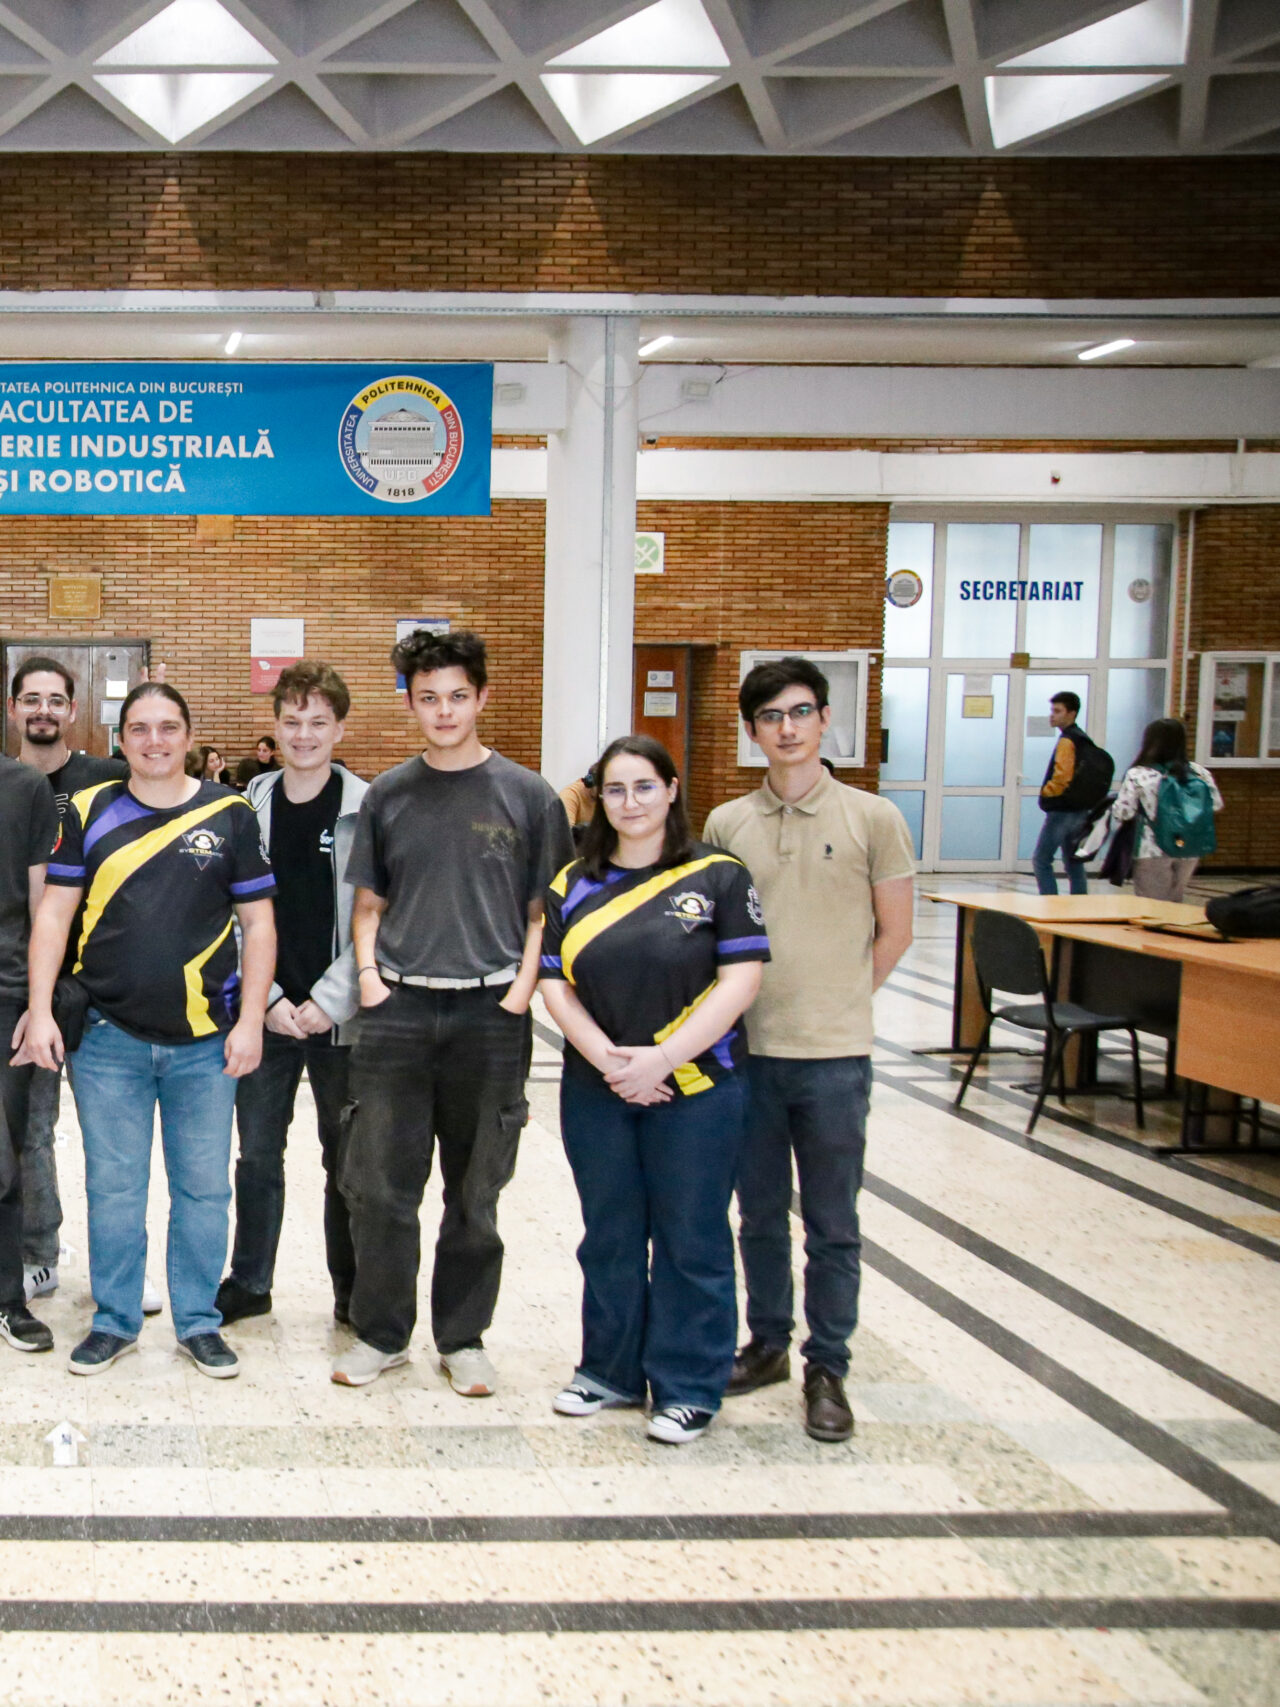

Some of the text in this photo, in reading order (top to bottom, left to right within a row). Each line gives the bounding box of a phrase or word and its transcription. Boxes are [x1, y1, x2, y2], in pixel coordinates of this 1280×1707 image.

[45, 382, 135, 394] POLITEHNICA
[140, 382, 165, 394] DIN
[170, 382, 243, 397] BUCUREȘTI
[361, 380, 441, 405] POLITEHNICA
[159, 400, 193, 423] DE
[71, 429, 275, 458] INDUSTRIALĂ
[344, 413, 375, 489] UNIVERSITATEA
[427, 410, 458, 488] DIN BUCUREȘTI
[29, 463, 186, 493] ROBOTICĂ
[387, 487, 415, 497] 1818
[960, 580, 1084, 601] SECRETARIAT
